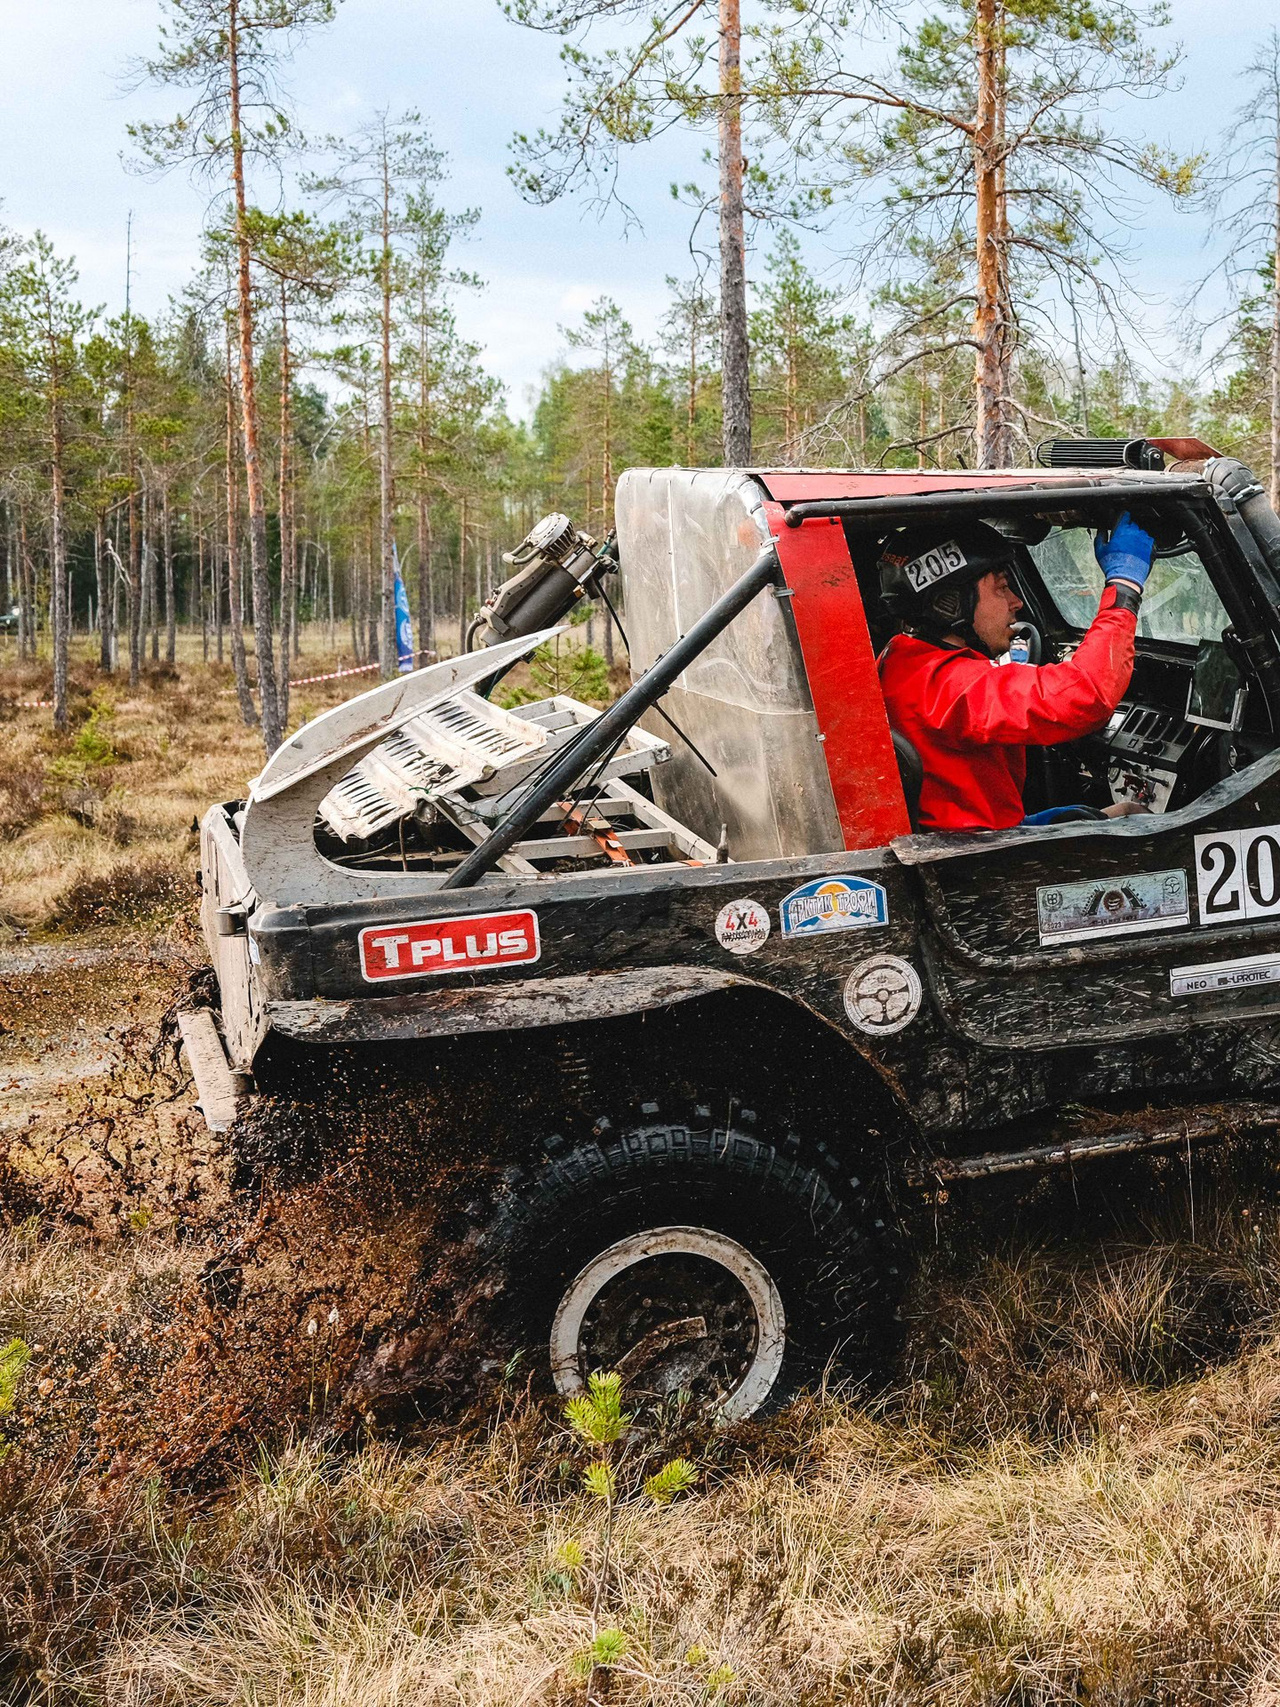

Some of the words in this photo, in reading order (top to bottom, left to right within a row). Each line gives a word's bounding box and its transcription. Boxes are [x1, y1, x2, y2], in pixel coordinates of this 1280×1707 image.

[908, 544, 962, 588] 205
[789, 894, 834, 930] АРКТИК
[836, 888, 878, 917] ТРОФИ
[1186, 980, 1207, 990] NEO
[1229, 971, 1271, 984] SUPROTEC
